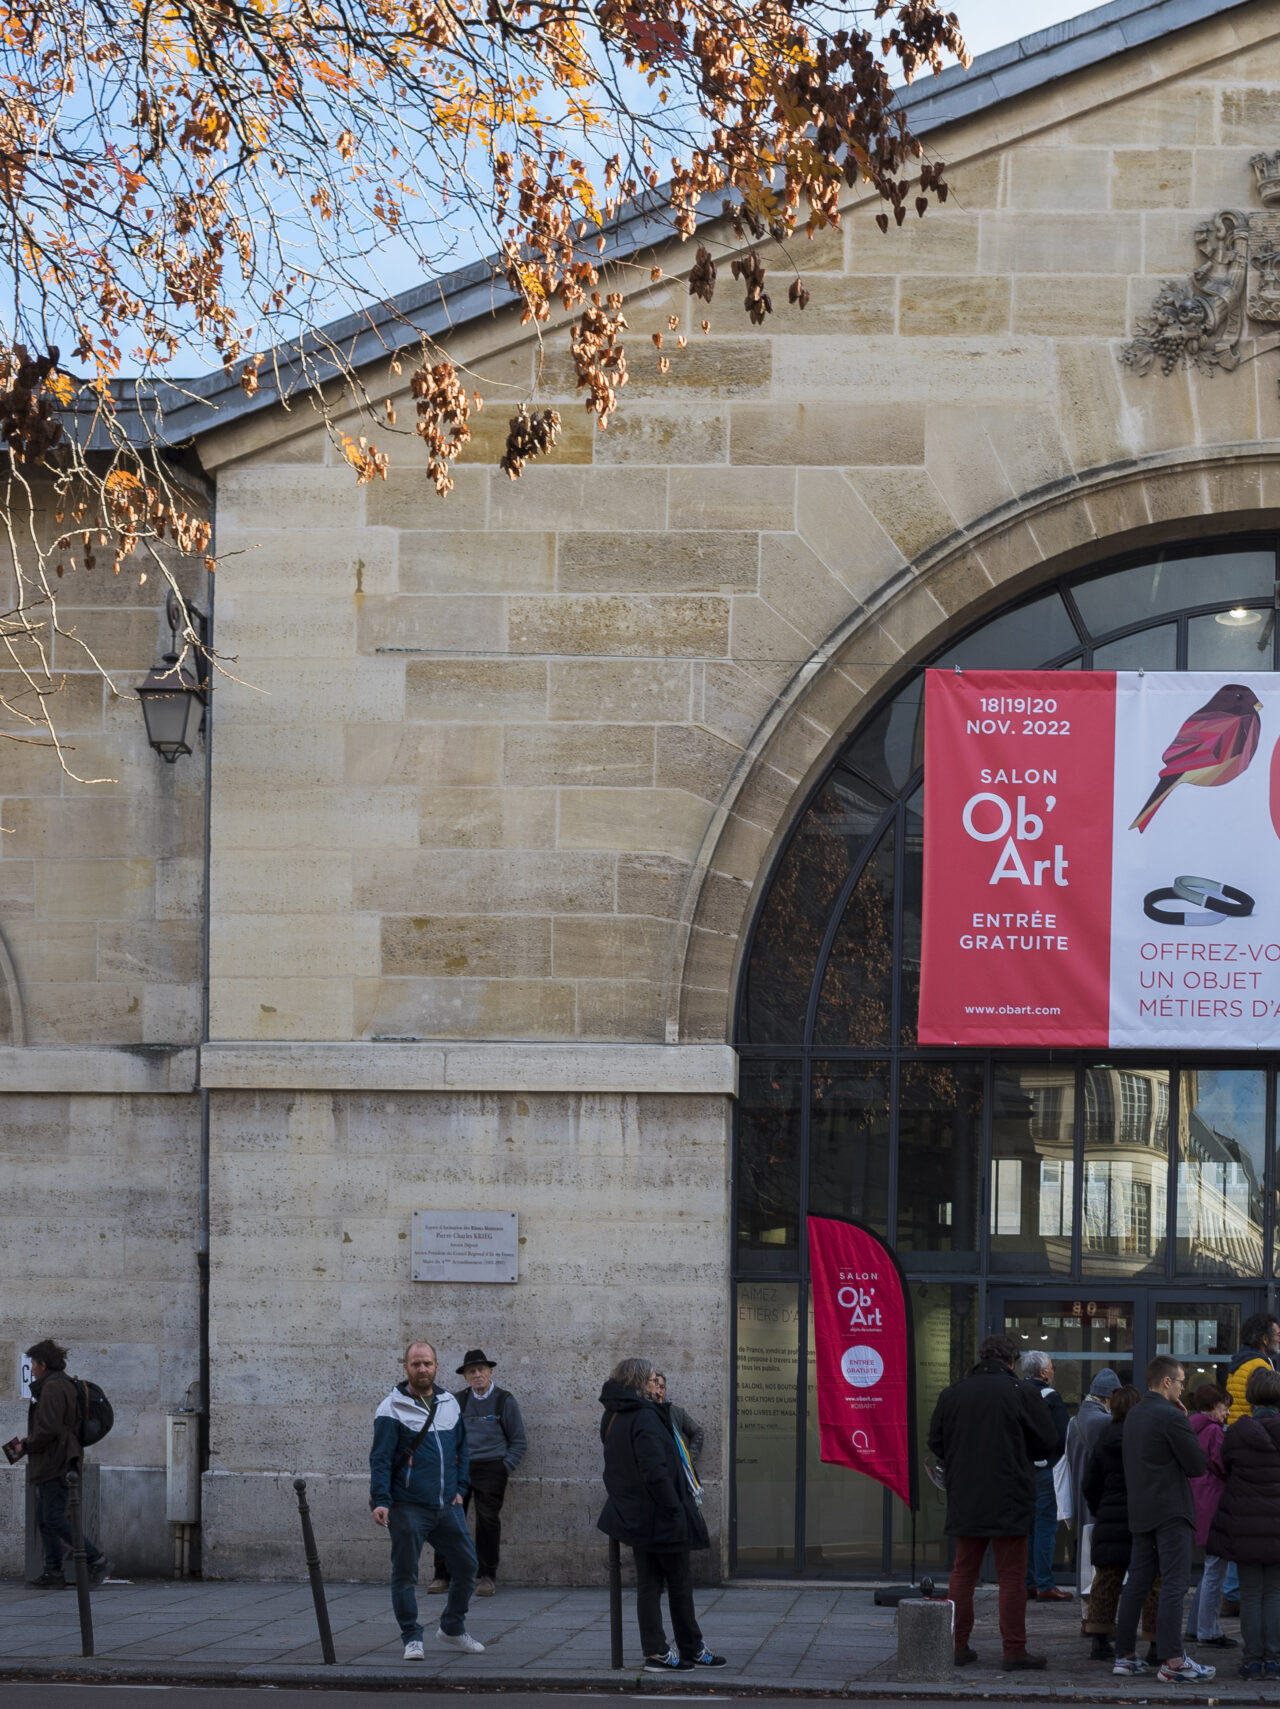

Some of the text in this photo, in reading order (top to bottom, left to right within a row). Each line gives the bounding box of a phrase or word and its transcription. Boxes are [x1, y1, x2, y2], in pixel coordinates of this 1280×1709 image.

[966, 719, 1070, 736] NOV. 2022
[980, 768, 1057, 784] SALON
[988, 836, 1069, 887] Art
[973, 910, 1057, 928] ENTRÉE
[960, 935, 1068, 951] GRATUITE
[1140, 971, 1263, 990] UN OBJET
[965, 1004, 1060, 1016] www.obart.com
[1139, 994, 1243, 1017] MÉTIERS
[839, 1272, 878, 1281] SALON
[741, 1287, 777, 1302] AIMEZ
[850, 1304, 882, 1326] Art
